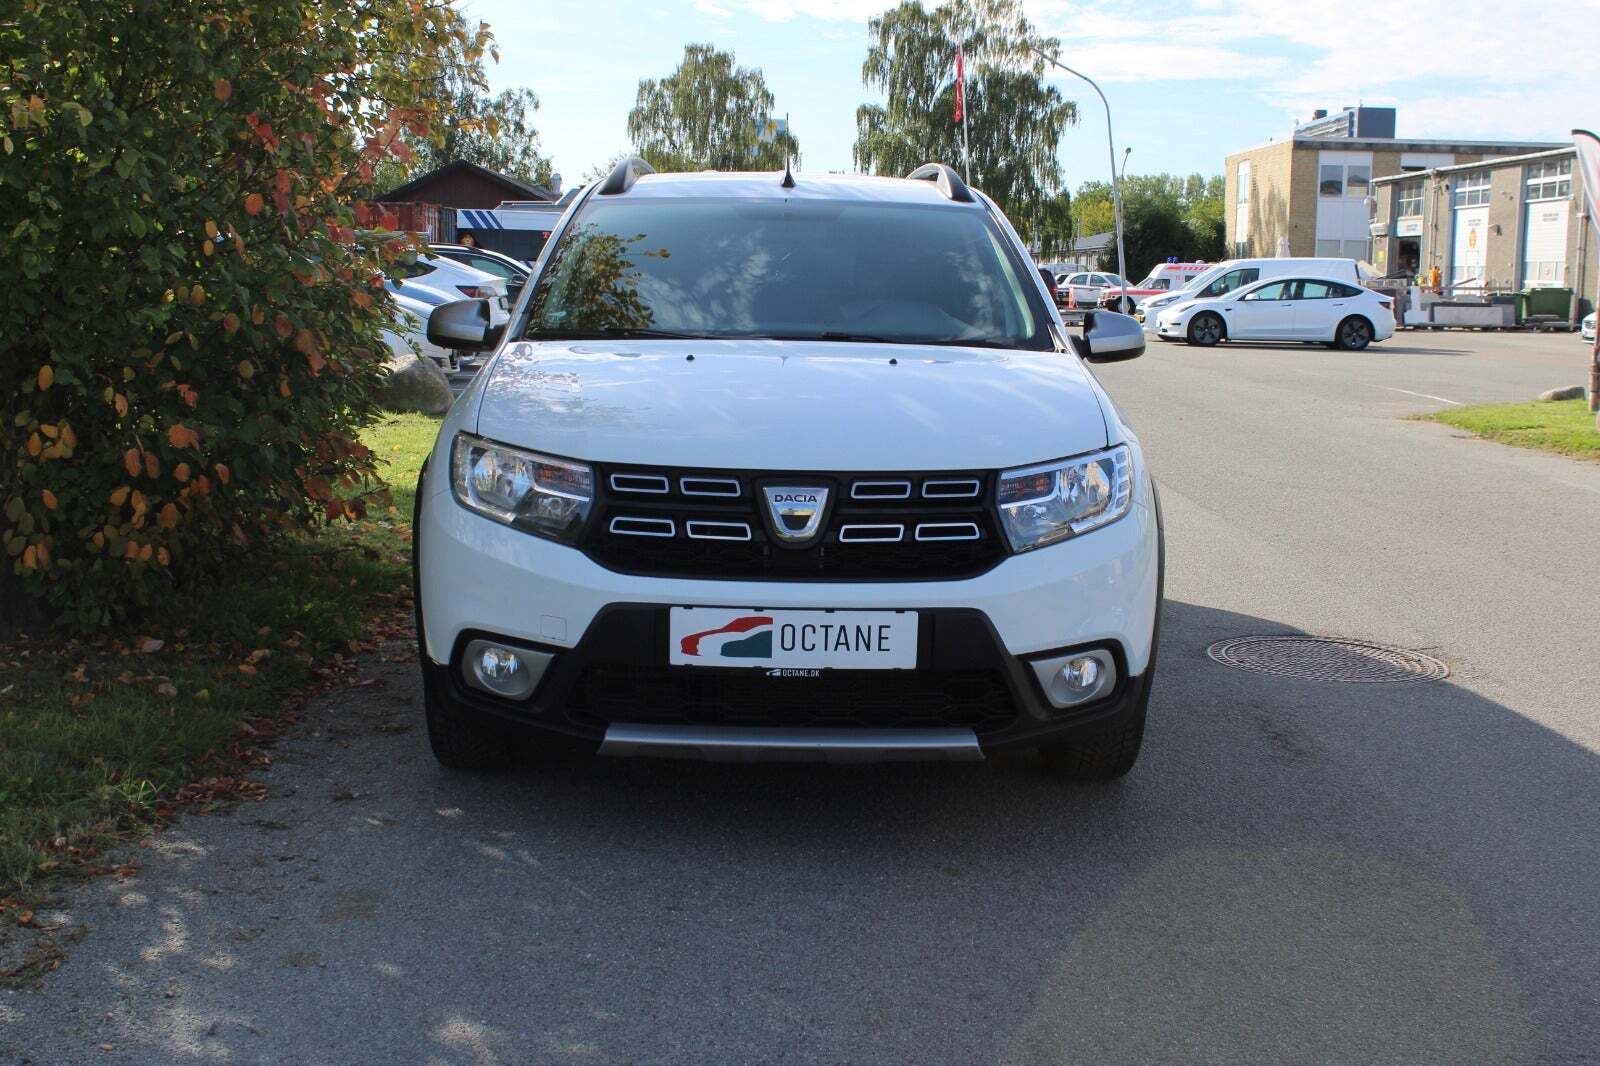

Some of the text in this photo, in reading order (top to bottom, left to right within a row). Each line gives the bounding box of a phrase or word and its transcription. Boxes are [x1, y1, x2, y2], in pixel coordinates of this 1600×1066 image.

[774, 494, 817, 502] DACIA
[780, 623, 891, 652] OCTANE
[782, 669, 820, 677] OCTANE.DK
